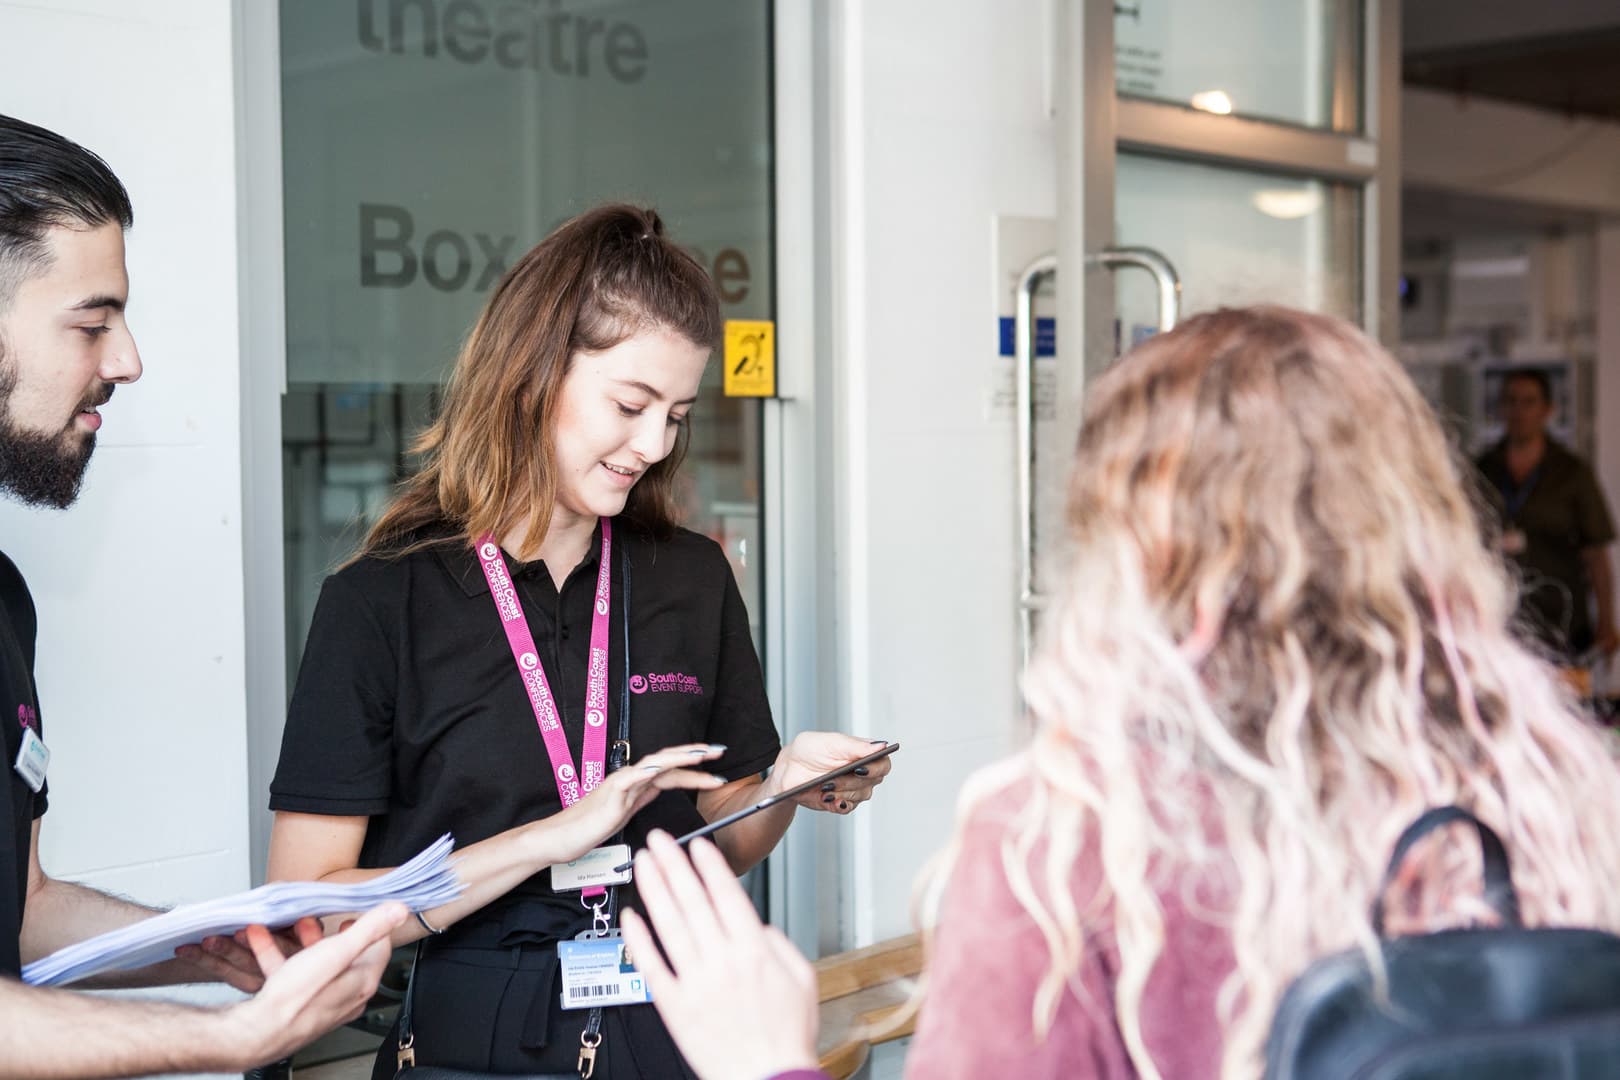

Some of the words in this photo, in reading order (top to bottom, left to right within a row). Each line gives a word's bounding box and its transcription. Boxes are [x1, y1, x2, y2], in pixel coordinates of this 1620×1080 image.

[358, 202, 516, 293] Box
[484, 562, 513, 622] CONFERENCES
[493, 559, 509, 587] South
[504, 588, 521, 620] Coast
[590, 648, 600, 677] Coast
[596, 650, 606, 709] CONFERENCES
[648, 672, 676, 684] South
[651, 683, 677, 693] EVENT
[524, 671, 550, 732] CONFERENCES
[532, 669, 549, 699] South
[543, 699, 559, 731] Coast
[588, 682, 599, 708] South
[583, 761, 594, 792] Coast
